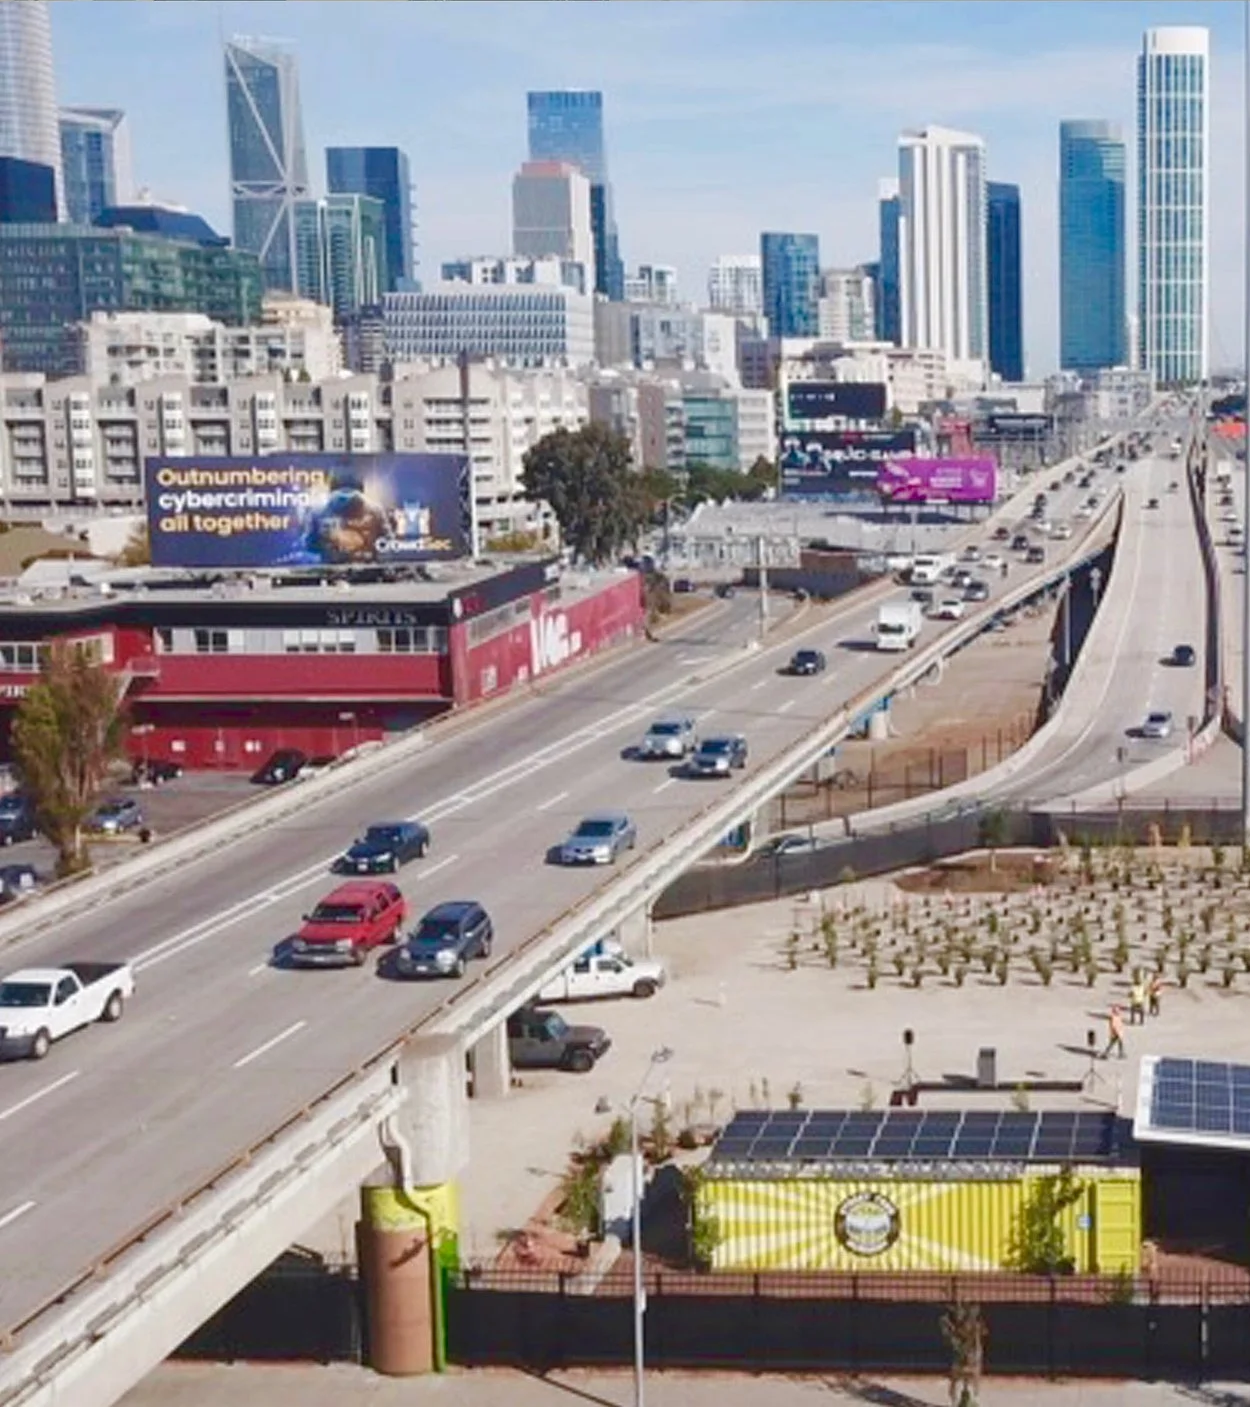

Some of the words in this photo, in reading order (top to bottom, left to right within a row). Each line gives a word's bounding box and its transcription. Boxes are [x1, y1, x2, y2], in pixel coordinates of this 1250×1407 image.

[157, 467, 325, 488] Outnumbering
[160, 512, 188, 532] all
[193, 510, 289, 534] together
[374, 536, 451, 552] CrowdSec
